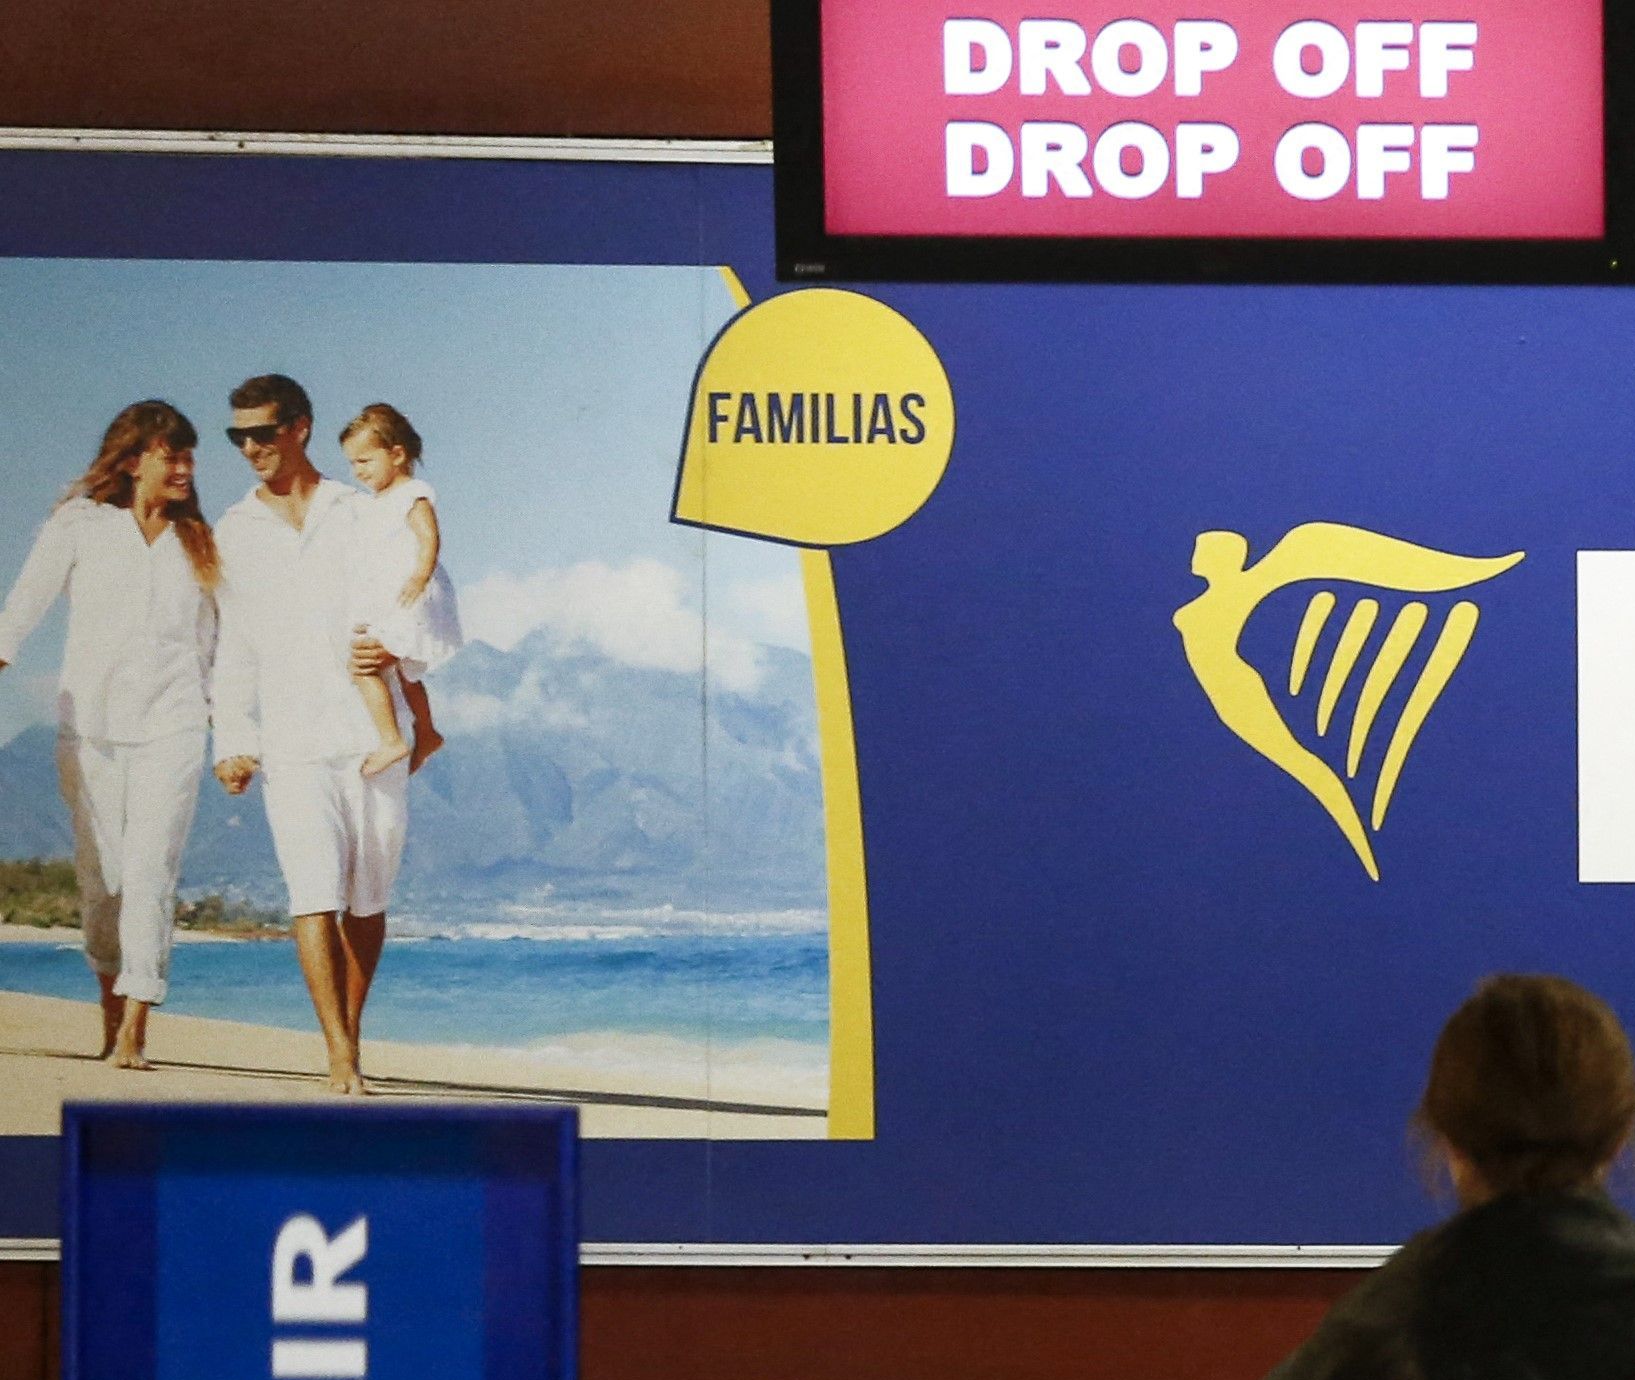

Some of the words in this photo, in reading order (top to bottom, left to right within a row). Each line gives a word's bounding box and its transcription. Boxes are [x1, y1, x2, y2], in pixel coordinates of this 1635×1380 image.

[943, 19, 1239, 98] DROP
[1272, 21, 1478, 98] OFF
[945, 121, 1240, 199] DROP
[1274, 122, 1479, 200] OFF
[707, 392, 926, 445] FAMILIAS
